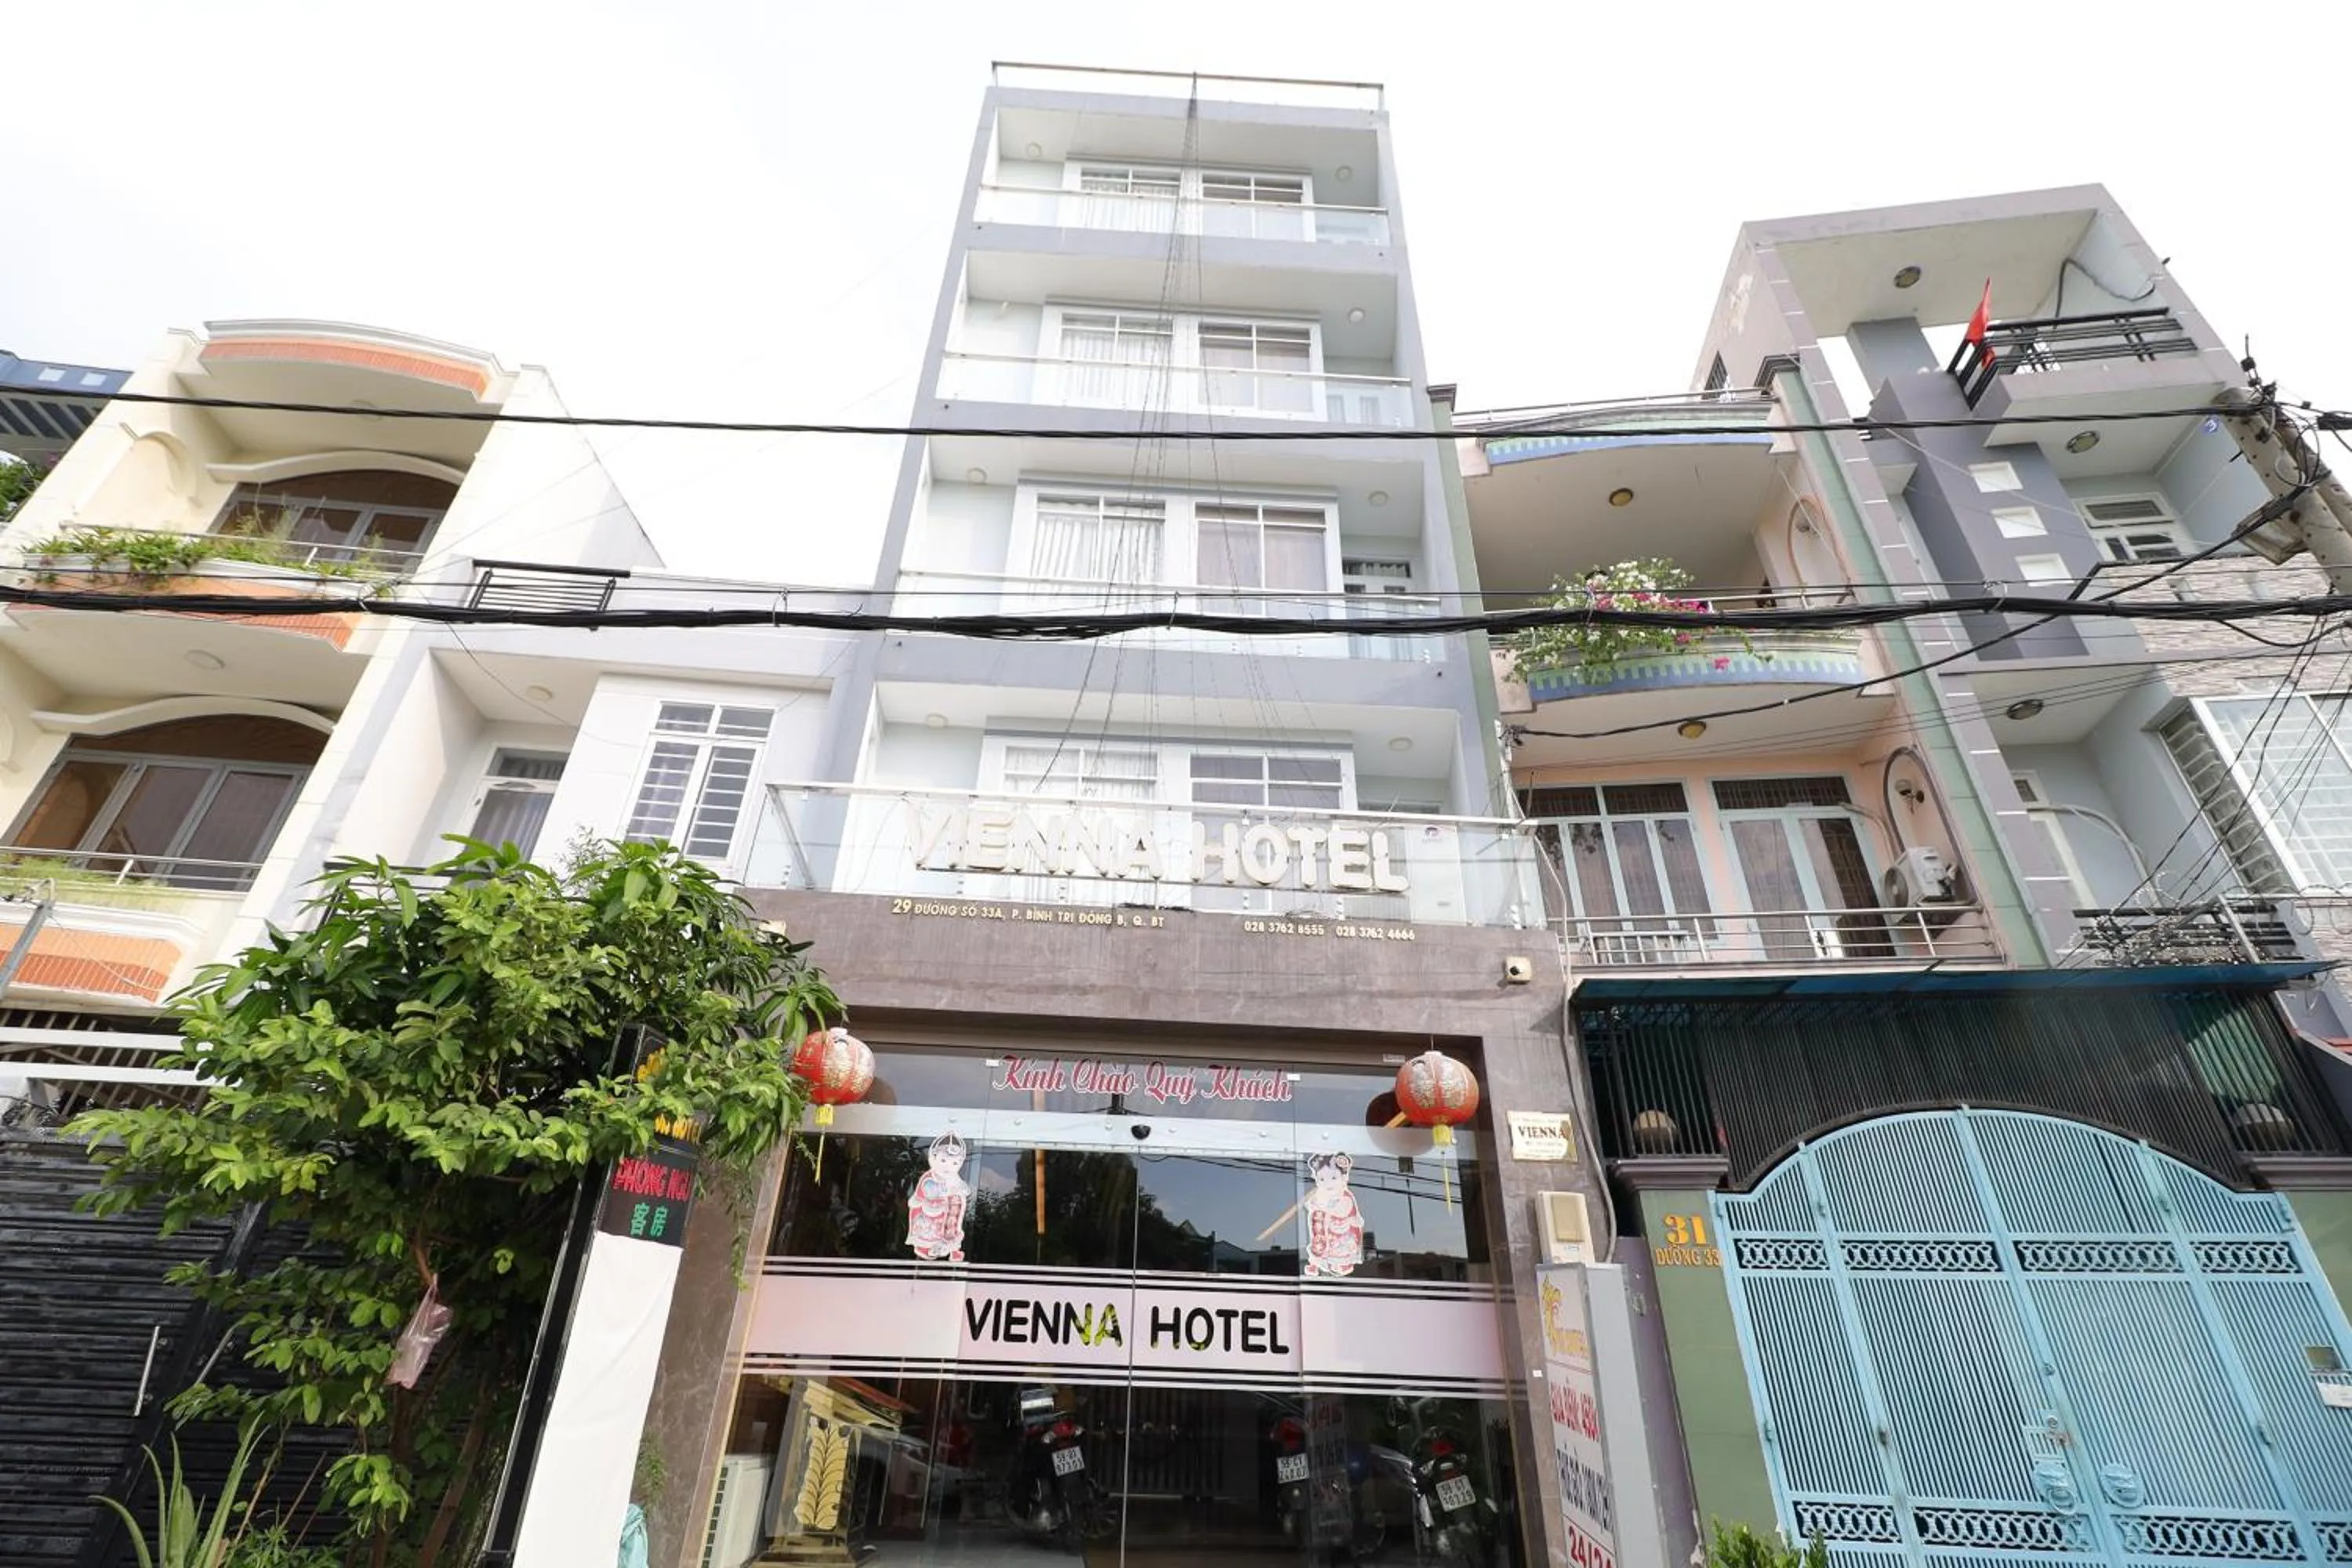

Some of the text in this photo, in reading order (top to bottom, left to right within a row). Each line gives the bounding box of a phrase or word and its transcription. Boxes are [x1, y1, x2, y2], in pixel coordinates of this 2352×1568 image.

[900, 801, 1409, 892] VIENNA HOTEL
[892, 898, 912, 914] 29
[1012, 909, 1022, 920] P.
[1151, 916, 1164, 927] BT
[1336, 925, 1356, 938] 028
[993, 1054, 1292, 1105] Kính Chào Quý Khách
[630, 1202, 668, 1237] 客房
[1664, 1214, 1707, 1246] 31
[966, 1298, 1290, 1354] VIENNA HOTEL
